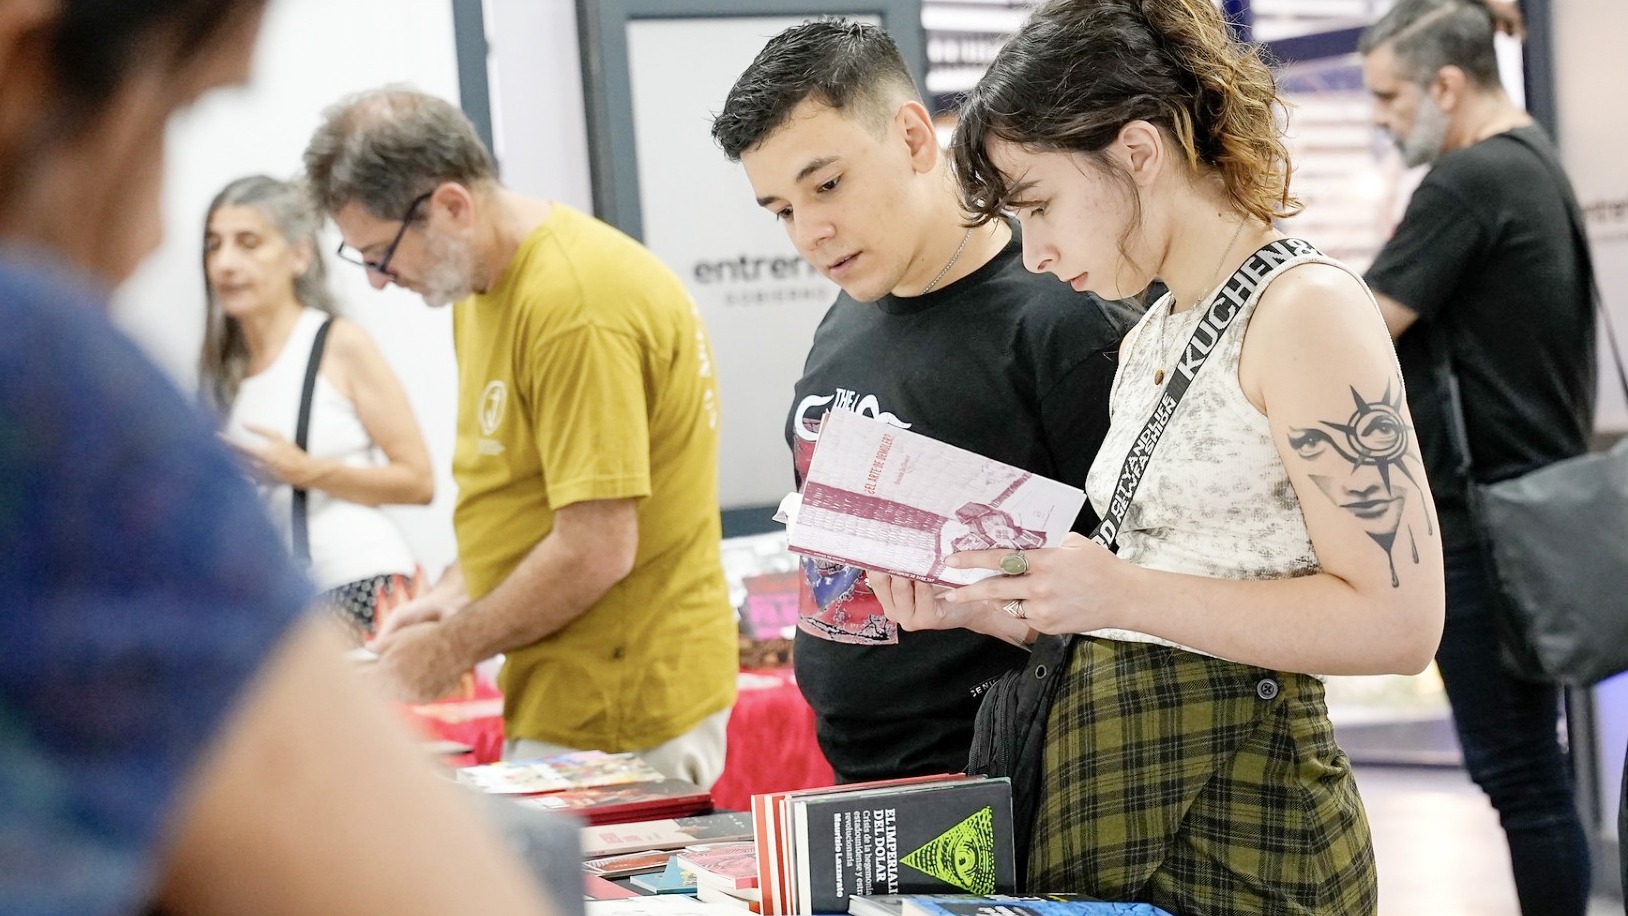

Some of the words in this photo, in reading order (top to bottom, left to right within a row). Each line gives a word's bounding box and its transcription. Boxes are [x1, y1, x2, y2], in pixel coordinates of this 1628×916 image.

[834, 813, 842, 852] Maurizio
[863, 810, 872, 833] Crisis
[873, 809, 885, 835] DEL
[885, 808, 896, 824] EL
[845, 812, 854, 867] revolucionaria
[854, 811, 863, 871] estadounidense
[864, 834, 872, 843] de
[864, 844, 872, 852] la
[835, 853, 844, 897] Lazzarato
[874, 837, 886, 882] DOLAR
[886, 825, 898, 895] IMPERIALI
